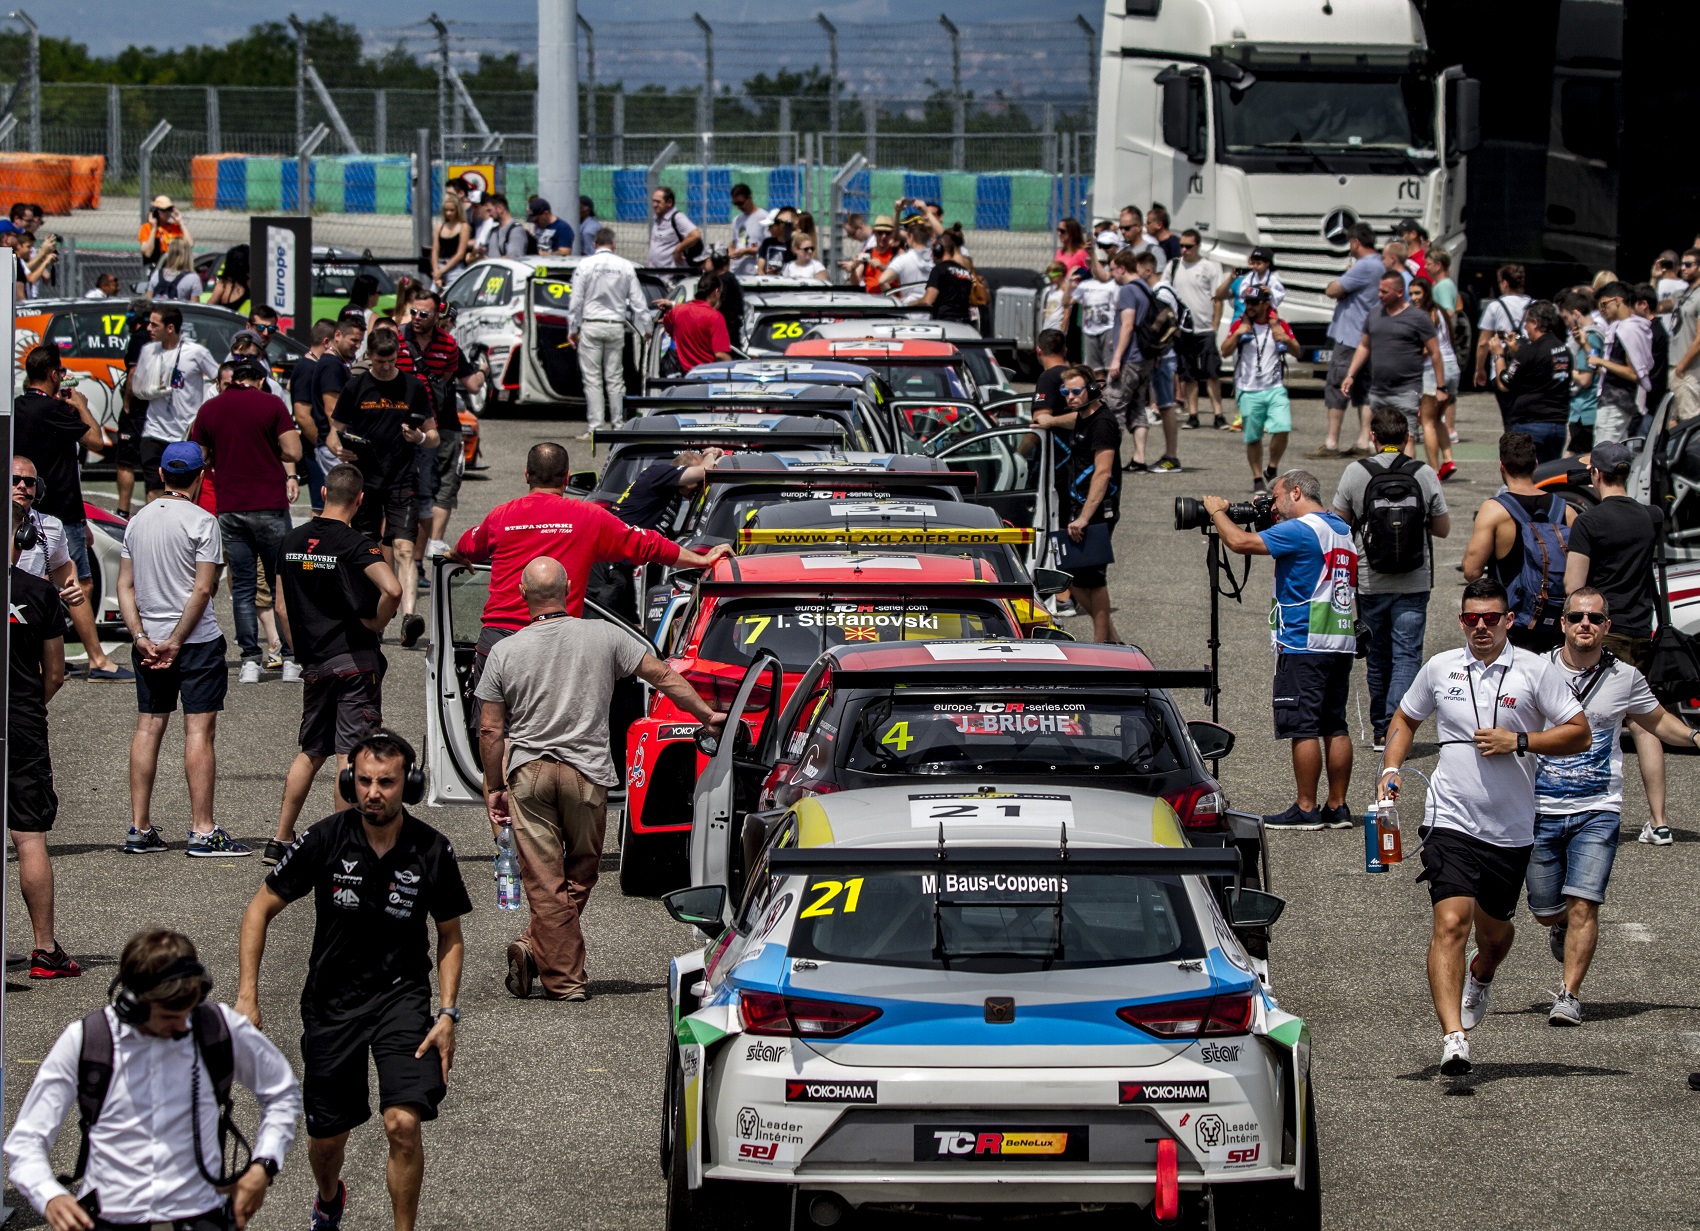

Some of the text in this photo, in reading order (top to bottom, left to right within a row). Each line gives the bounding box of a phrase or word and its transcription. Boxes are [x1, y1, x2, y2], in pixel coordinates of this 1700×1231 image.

[1398, 178, 1421, 200] rti
[274, 245, 288, 308] Europe
[101, 314, 126, 335] 17
[771, 321, 804, 340] 26
[849, 505, 923, 513] 34
[306, 538, 320, 553] 7
[285, 552, 338, 562] STEFANOVSKI
[777, 612, 939, 630] I. Stefanovski
[744, 616, 772, 645] 7
[933, 702, 1086, 713] europe.TCR-series.com
[955, 714, 1071, 733] J. BRICHE
[881, 721, 914, 752] 4
[929, 804, 1021, 819] 21
[921, 873, 1069, 895] M. Baus-Coppens
[799, 877, 865, 919] 21
[745, 1041, 786, 1063] star
[1200, 1042, 1241, 1063] star
[805, 1084, 875, 1099] YOKOHAMA
[1142, 1085, 1208, 1099] YOKOHAMA
[760, 1118, 803, 1132] Leader
[1225, 1121, 1259, 1132] Leader
[759, 1130, 804, 1145] Intérim
[933, 1131, 1053, 1155] TCR BeNeLux
[1226, 1132, 1261, 1144] Intérim
